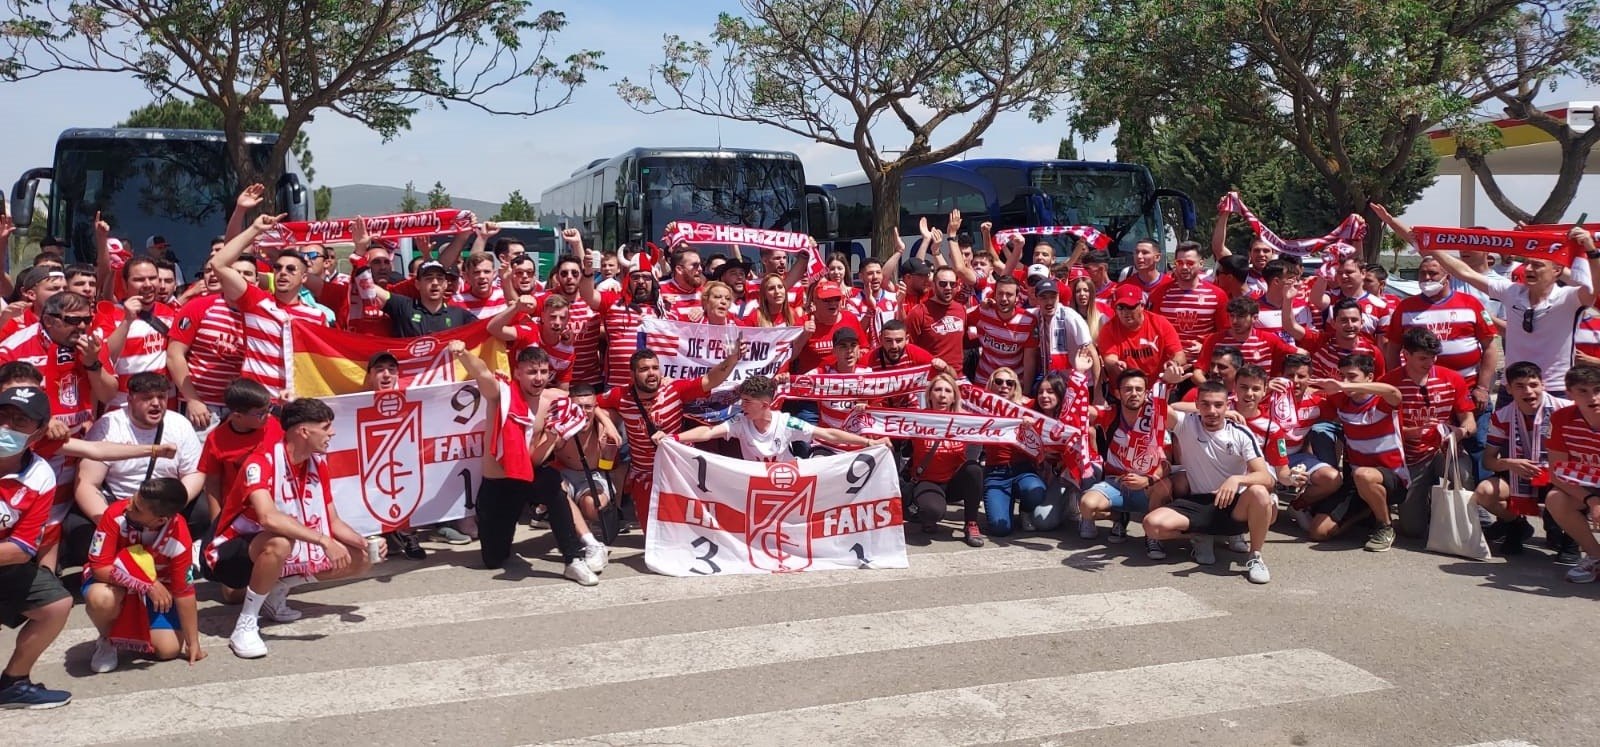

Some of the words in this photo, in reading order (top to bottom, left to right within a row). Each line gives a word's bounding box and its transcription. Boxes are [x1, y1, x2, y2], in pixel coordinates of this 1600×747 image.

[1435, 233, 1515, 249] GRANADA
[687, 338, 704, 359] DE
[983, 335, 1018, 352] Platzi
[663, 365, 676, 379] TE
[732, 369, 742, 381] A
[451, 384, 481, 425] 9
[960, 383, 1045, 436] GRANAA
[884, 415, 938, 436] Eterna
[944, 417, 1006, 439] Lucha
[433, 433, 484, 463] FAN
[457, 467, 476, 510] 1
[691, 453, 712, 494] 1
[846, 453, 877, 494] 9
[823, 501, 892, 537] FANS
[689, 536, 722, 576] 3
